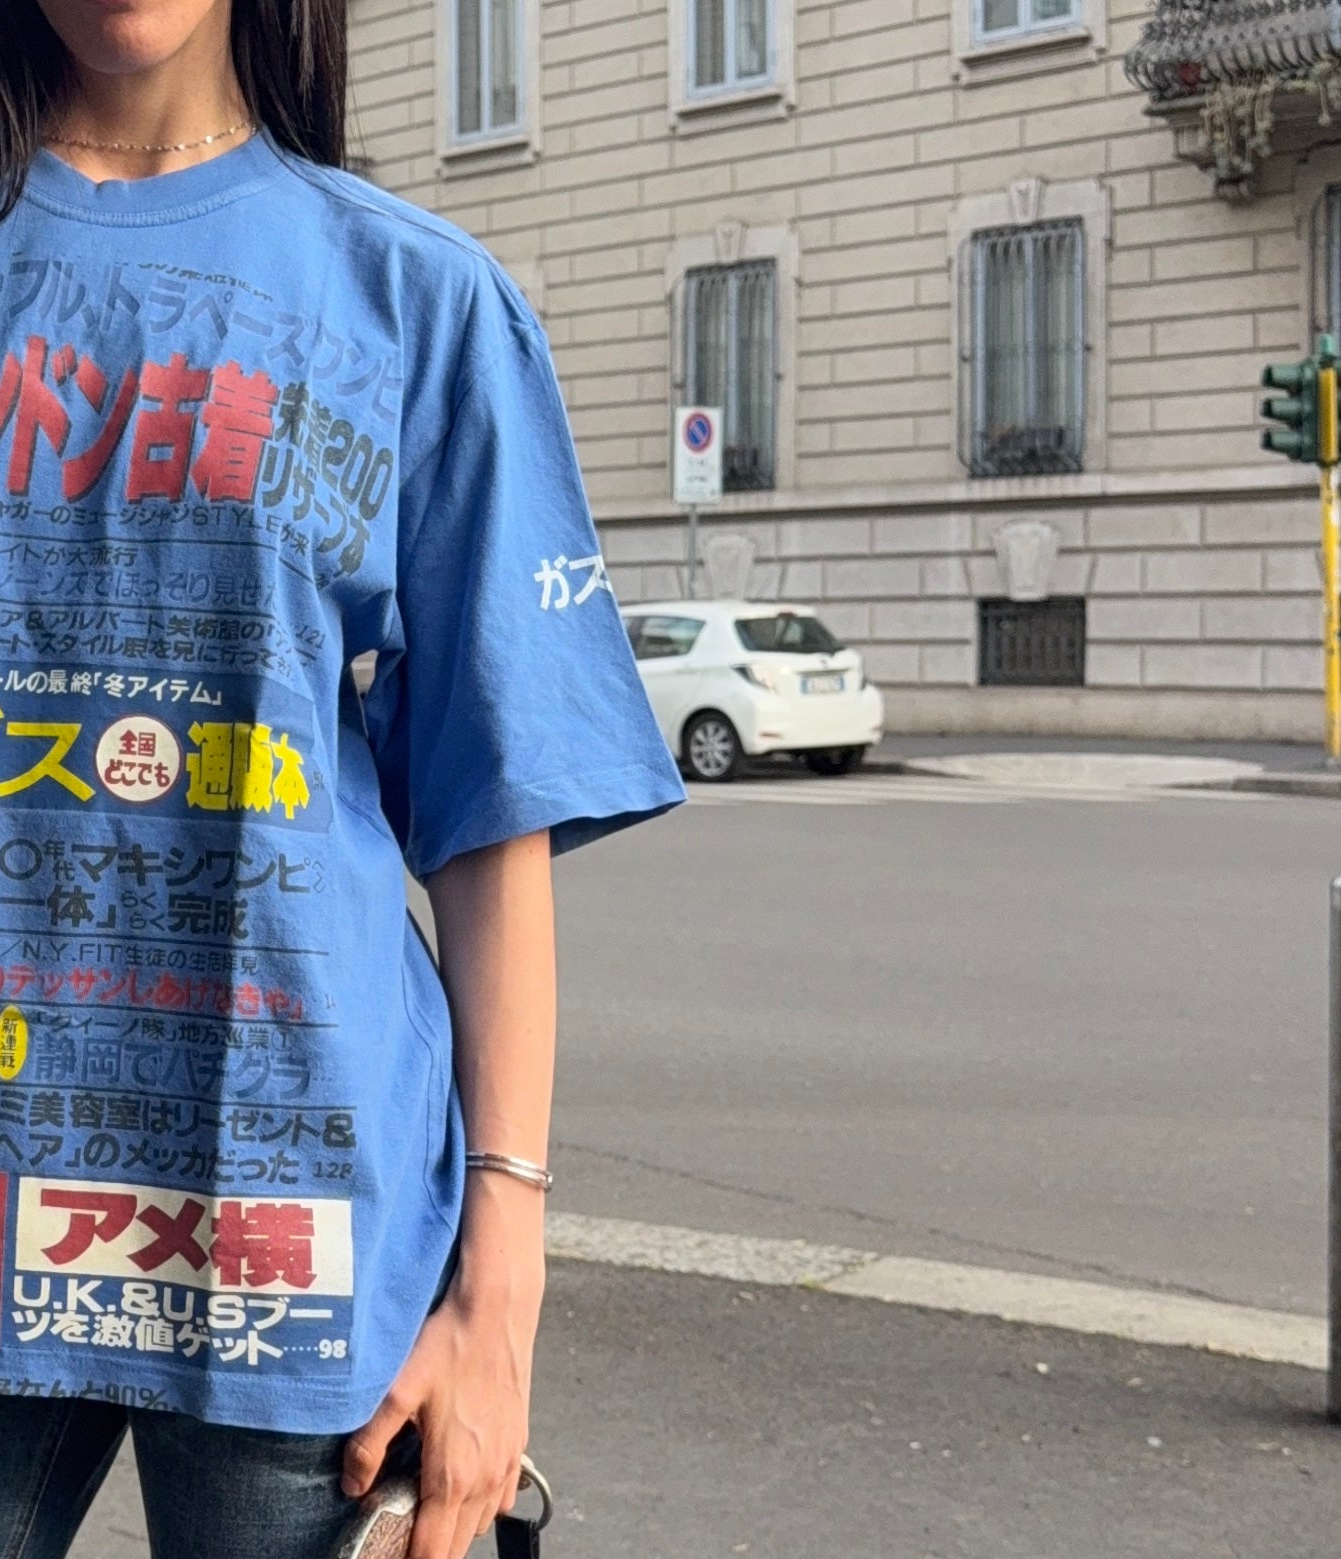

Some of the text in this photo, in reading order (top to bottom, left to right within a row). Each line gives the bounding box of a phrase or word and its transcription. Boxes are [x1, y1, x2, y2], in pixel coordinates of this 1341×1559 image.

[532, 554, 615, 612] ガス
[118, 728, 157, 757] 全国
[104, 758, 171, 787] どこでも
[40, 1187, 318, 1290] アメ横
[317, 1338, 348, 1361] 98
